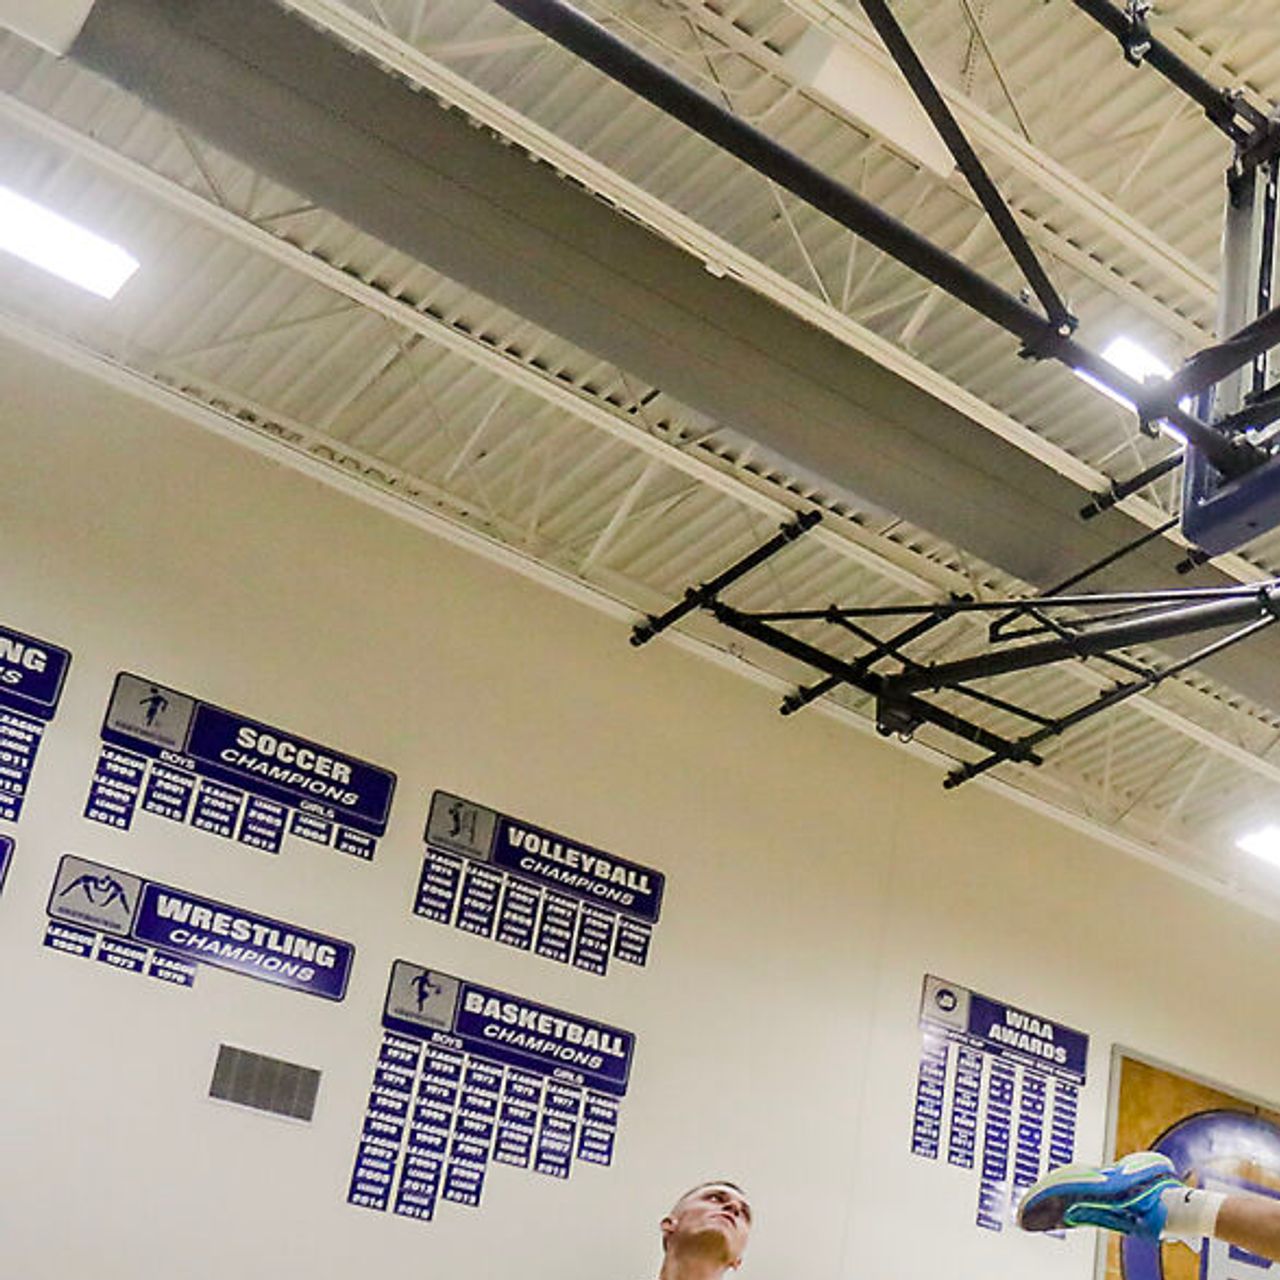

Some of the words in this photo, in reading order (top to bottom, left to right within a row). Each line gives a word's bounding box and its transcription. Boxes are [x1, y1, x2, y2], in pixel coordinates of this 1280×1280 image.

[160, 750, 195, 770] BOYS
[220, 749, 359, 806] CHAMPIONS
[236, 727, 352, 785] SOCCER
[300, 799, 336, 819] GIRLS
[507, 827, 653, 895] VOLLEYBALL
[520, 857, 636, 906] CHAMPIONS
[156, 894, 337, 969] WRESTLING
[169, 929, 316, 982] CHAMPIONS
[464, 991, 627, 1058] BASKETBALL
[483, 1024, 604, 1070] CHAMPIONS
[989, 1024, 1067, 1064] AWARDS
[1006, 1010, 1053, 1040] WIAA
